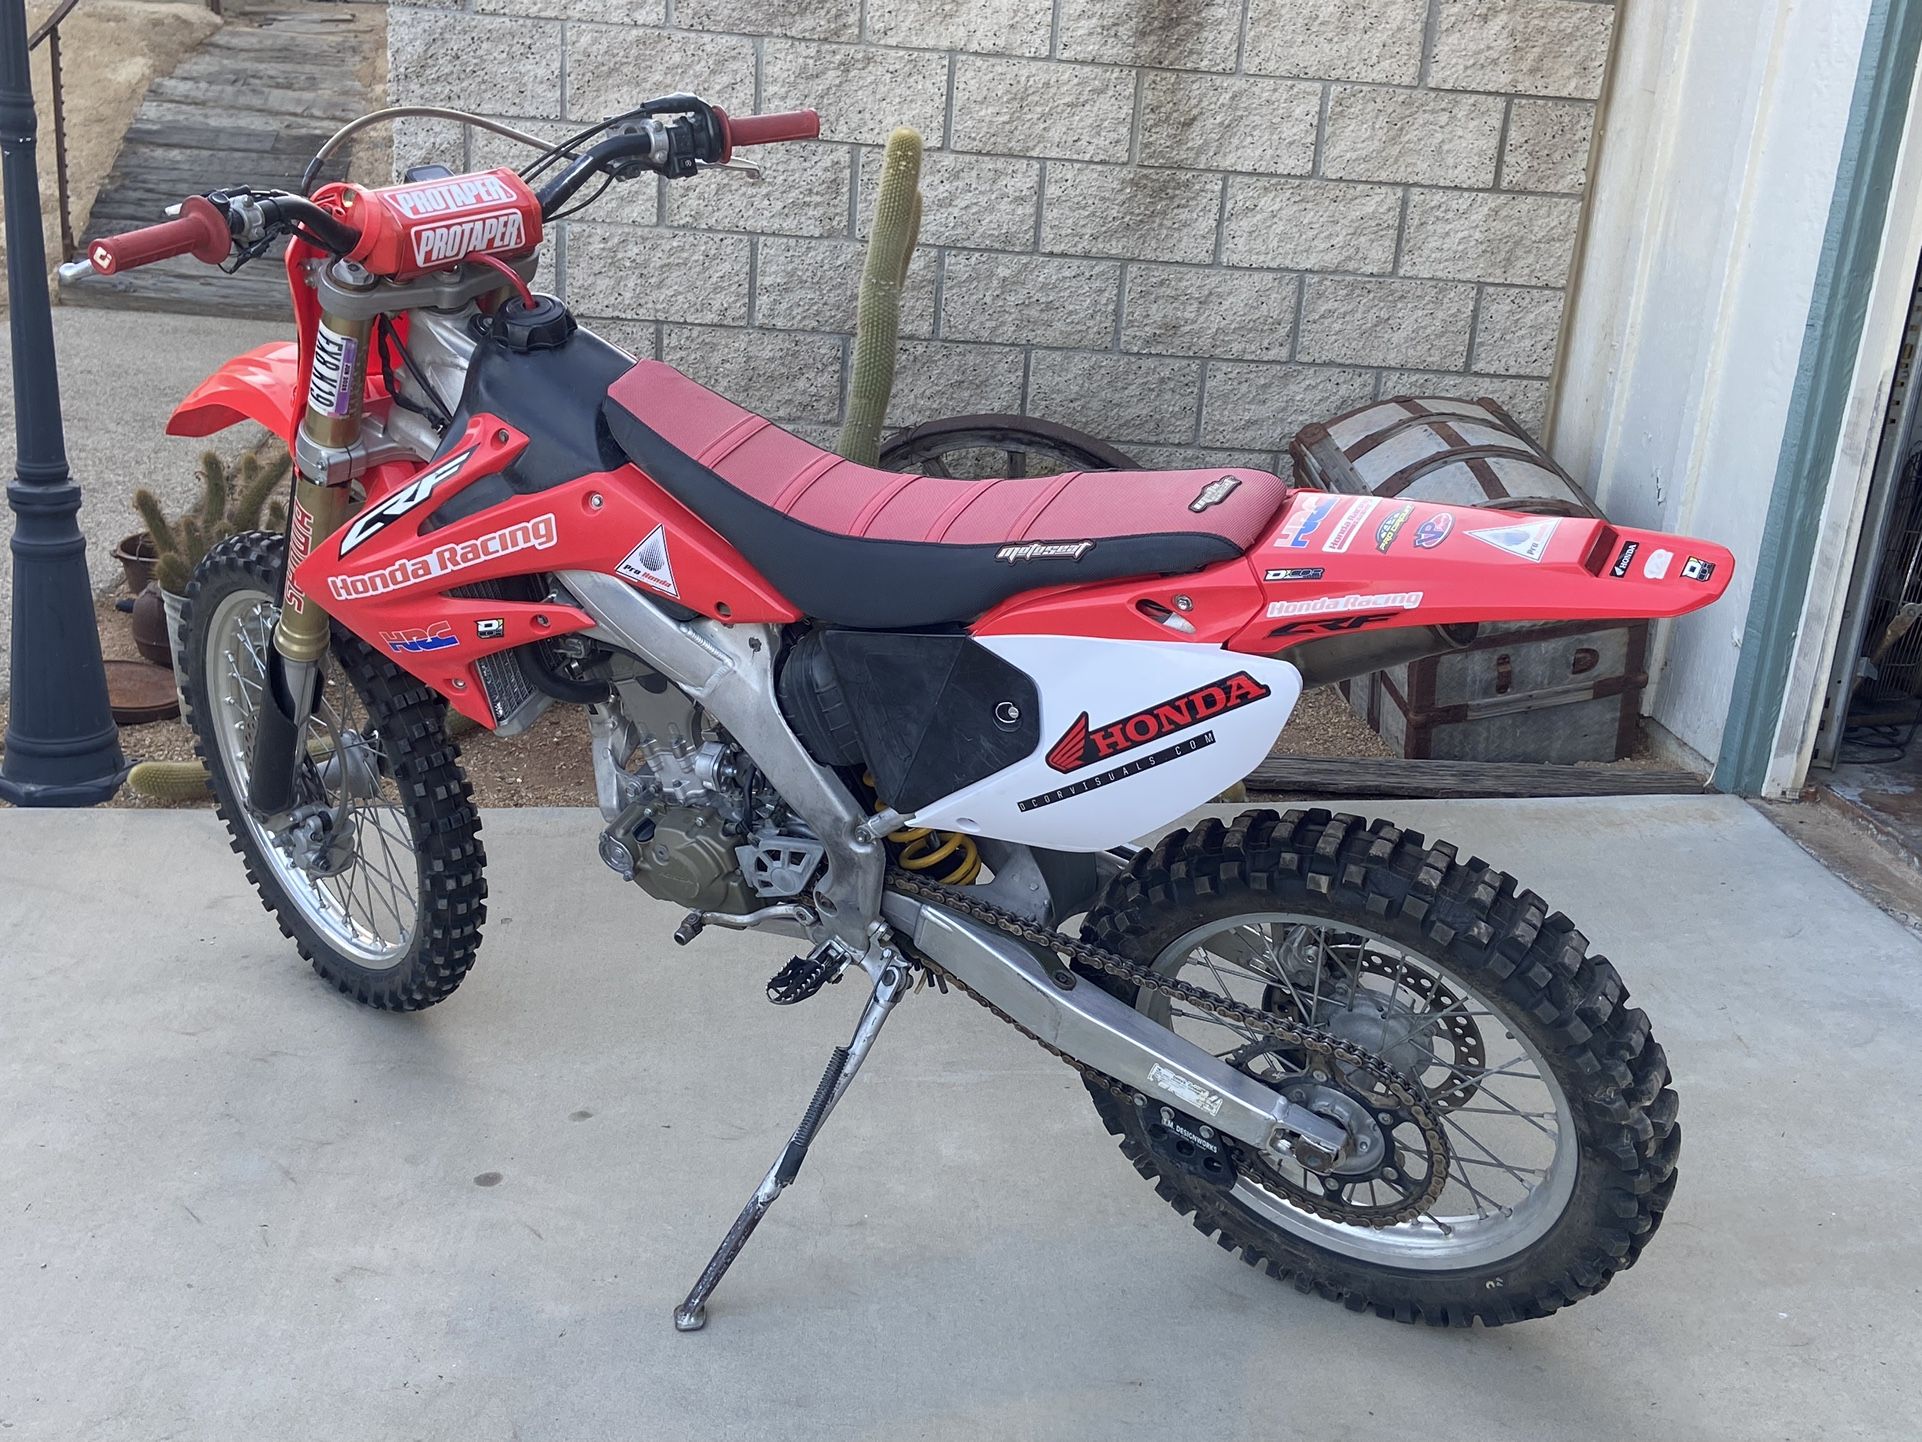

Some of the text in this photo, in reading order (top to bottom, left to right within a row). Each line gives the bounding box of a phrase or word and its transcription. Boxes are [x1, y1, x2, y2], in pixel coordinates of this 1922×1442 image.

[394, 176, 506, 216] PROTAPER
[417, 213, 521, 267] PROTAPER
[339, 449, 474, 559] CRF
[330, 515, 555, 599] Honda Racing
[623, 564, 671, 588] Pro Honda
[1619, 544, 1637, 569] HONDA
[1268, 592, 1422, 617] Honda Racing
[379, 620, 460, 652] HRC
[1090, 674, 1266, 757] HONDA
